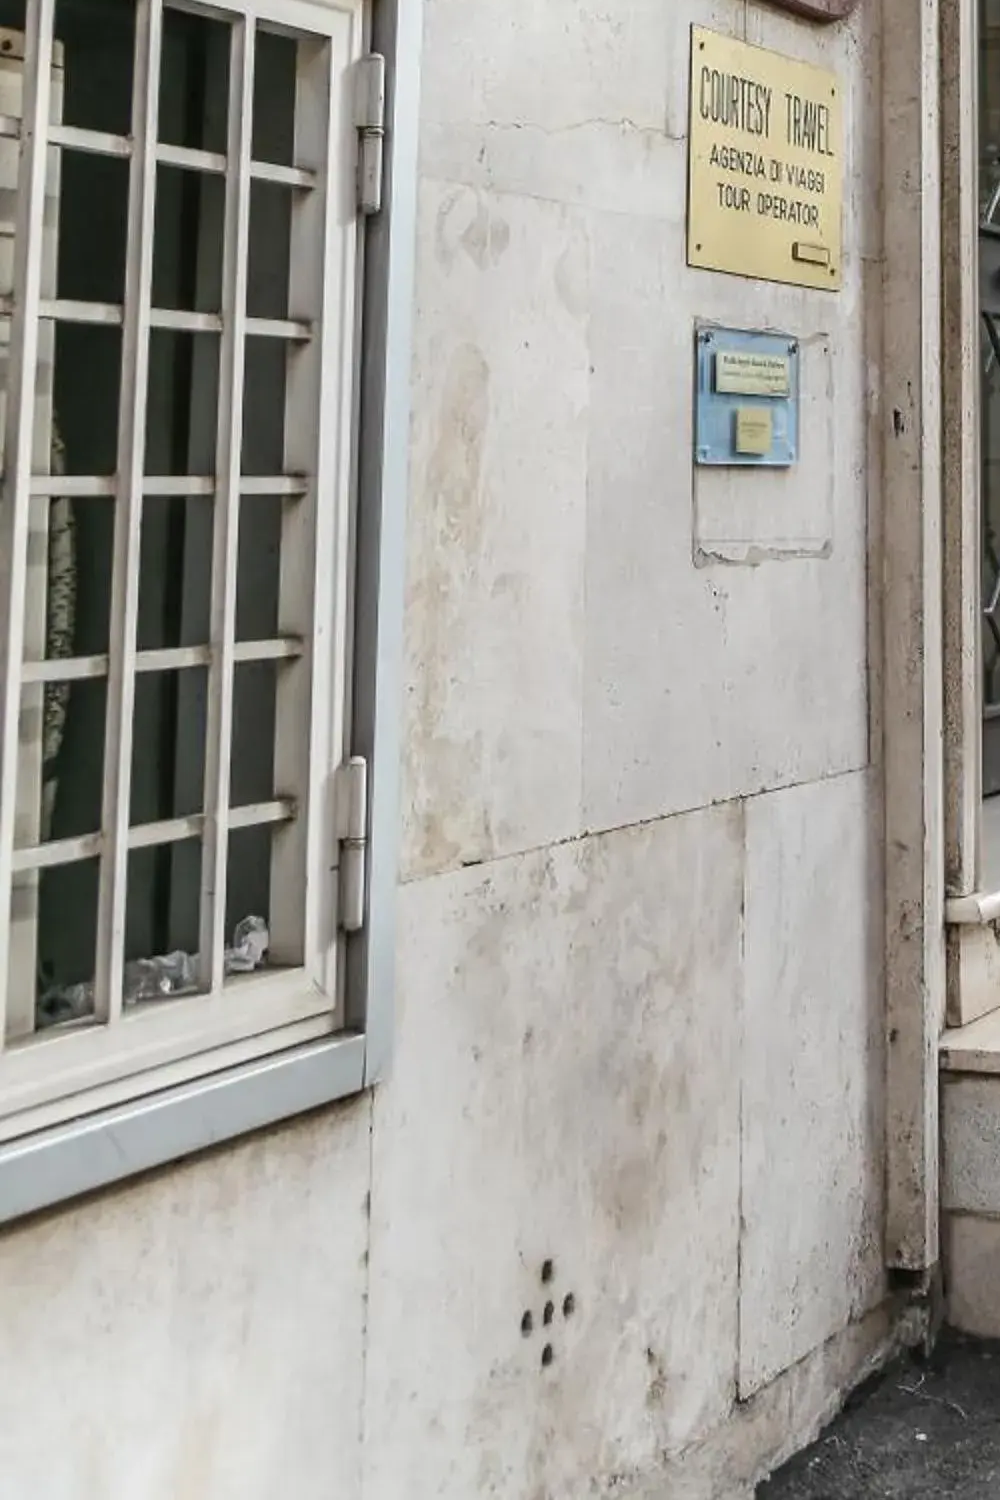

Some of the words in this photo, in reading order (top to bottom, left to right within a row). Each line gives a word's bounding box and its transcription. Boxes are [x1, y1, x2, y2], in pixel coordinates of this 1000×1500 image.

[699, 66, 772, 139] COURTESY
[784, 93, 835, 157] TRAVEL
[708, 143, 766, 177] AGENZIA
[770, 159, 784, 183] DI
[785, 163, 826, 195] VIAGGI
[716, 182, 751, 213] TOUR
[756, 192, 820, 229] OPERATOR
